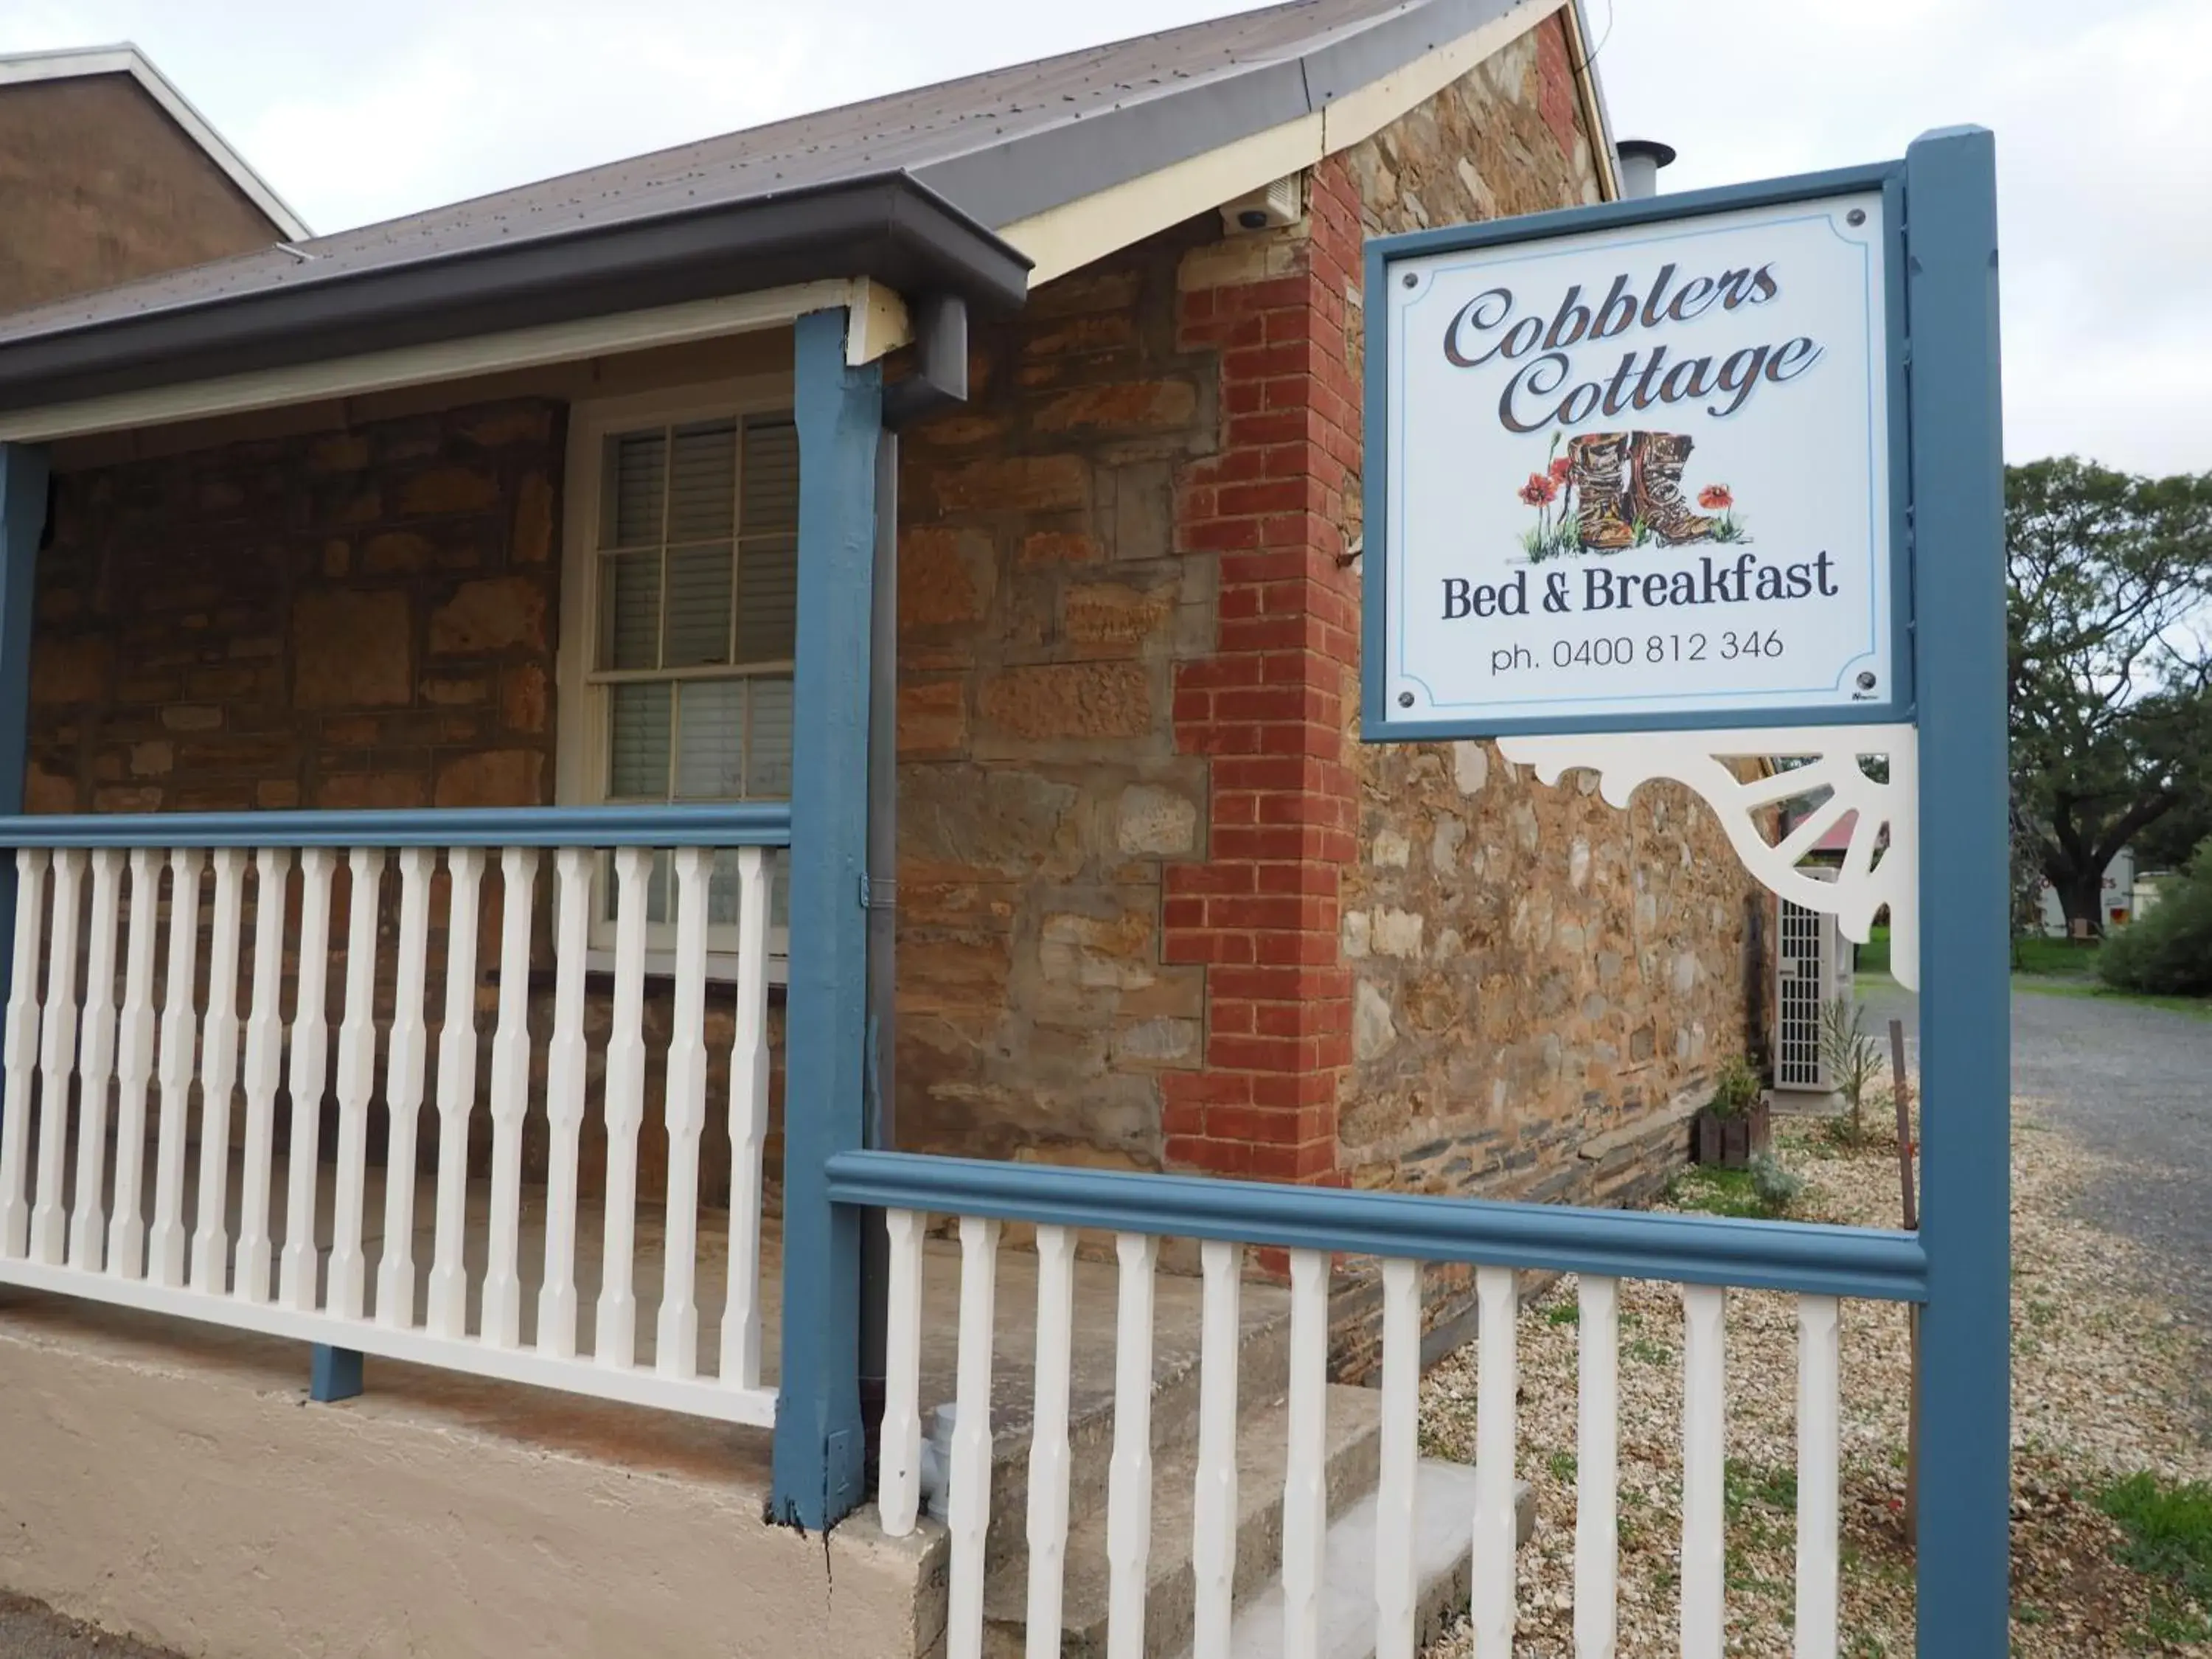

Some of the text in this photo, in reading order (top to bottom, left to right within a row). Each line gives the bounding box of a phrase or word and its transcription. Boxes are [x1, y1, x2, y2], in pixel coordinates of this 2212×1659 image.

[1443, 260, 1779, 368] Cobblers
[1498, 335, 1825, 434] Cottage
[1441, 550, 1839, 620] Bed & Breakfast
[1491, 630, 1784, 676] ph. 0400 812 346
